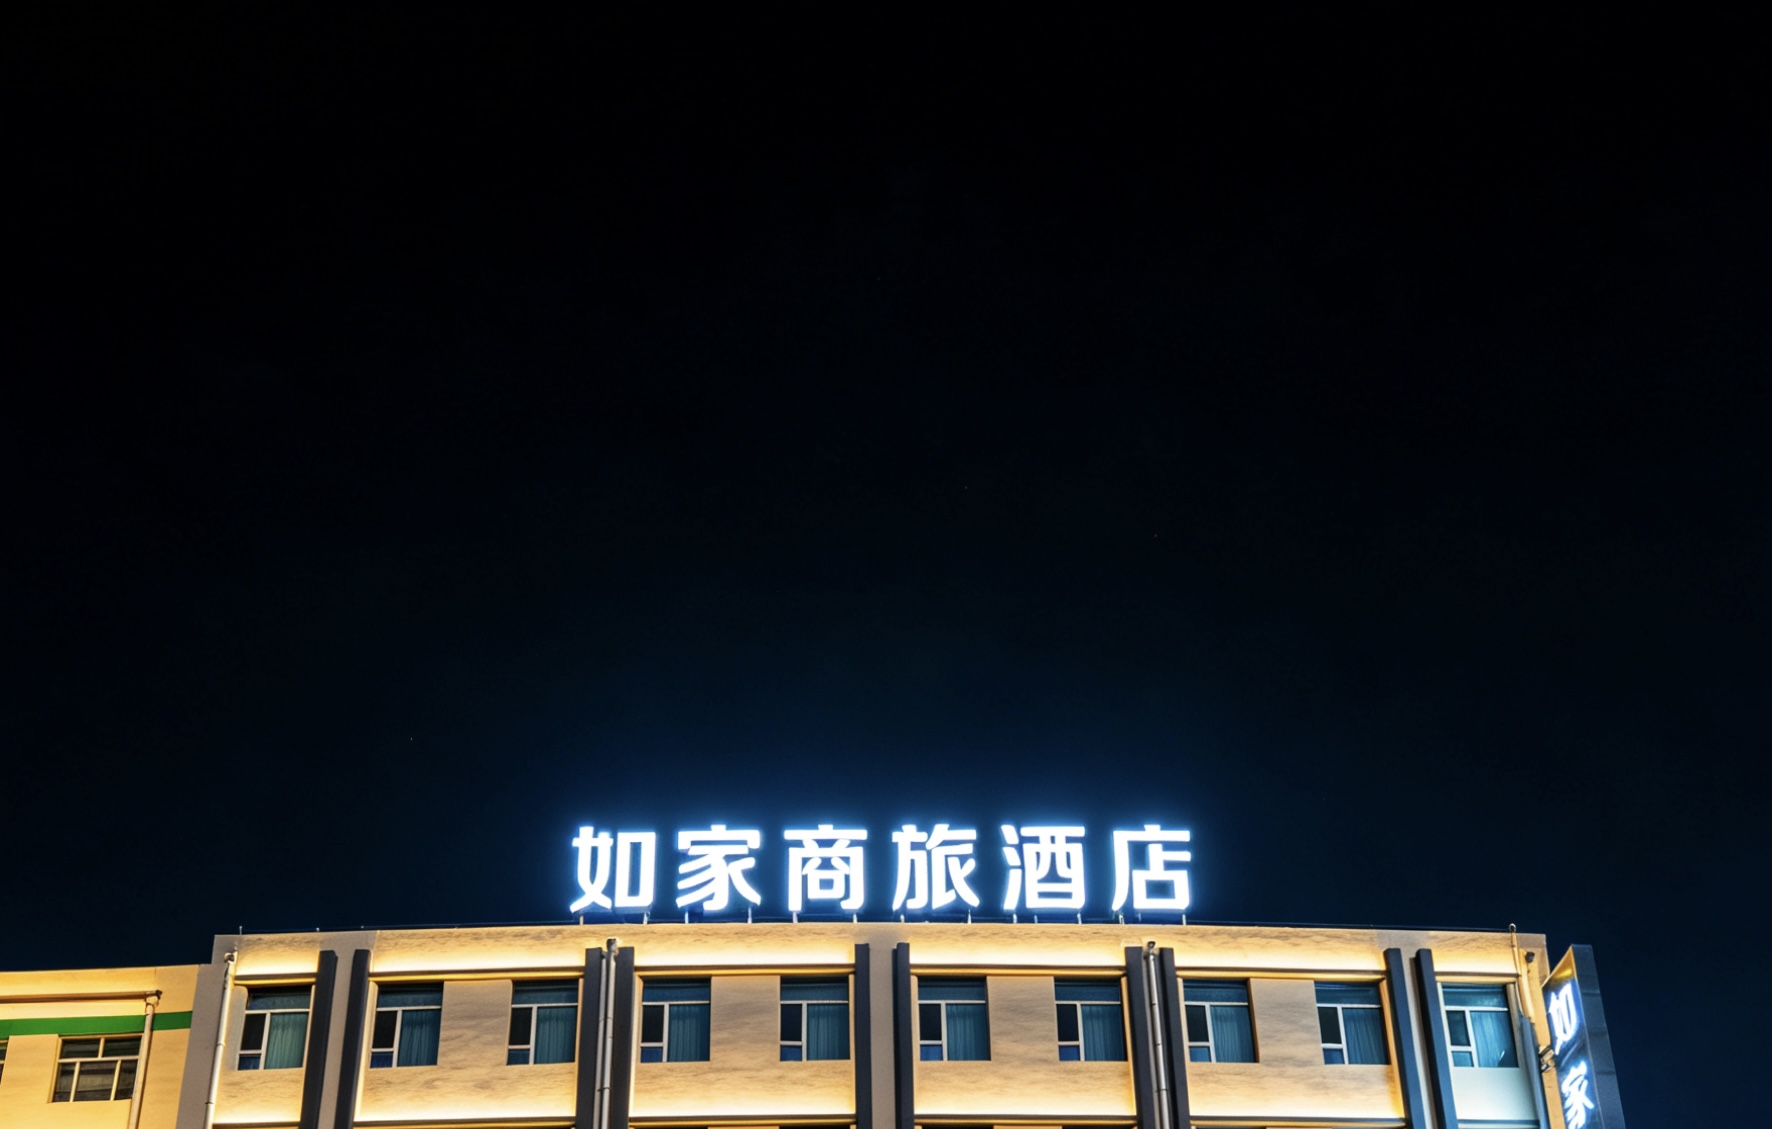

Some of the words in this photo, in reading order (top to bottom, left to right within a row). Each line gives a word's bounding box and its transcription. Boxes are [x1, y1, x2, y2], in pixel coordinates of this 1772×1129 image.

[569, 823, 1192, 913] 如家商旅酒店
